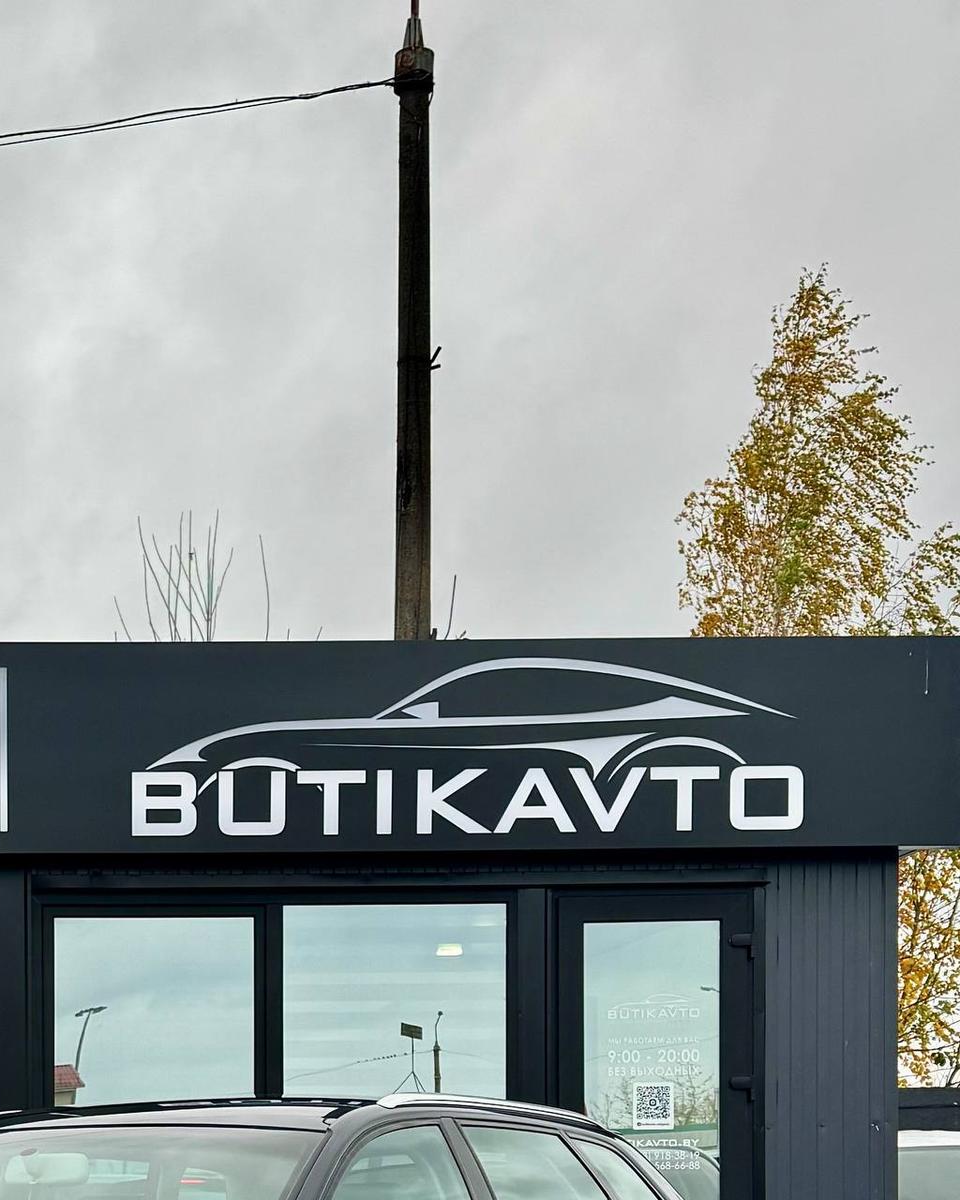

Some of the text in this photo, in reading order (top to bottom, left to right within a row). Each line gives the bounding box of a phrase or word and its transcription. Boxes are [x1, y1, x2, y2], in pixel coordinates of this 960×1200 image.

[131, 764, 804, 837] BUTIKAVTO
[607, 1008, 700, 1019] BUTIKAVTO
[607, 1049, 640, 1063] 9:00
[658, 1049, 700, 1063] 20:00
[607, 1065, 700, 1076] БЕЗ ВЫХОДНЫХ
[654, 1151, 700, 1160] 918-38-19
